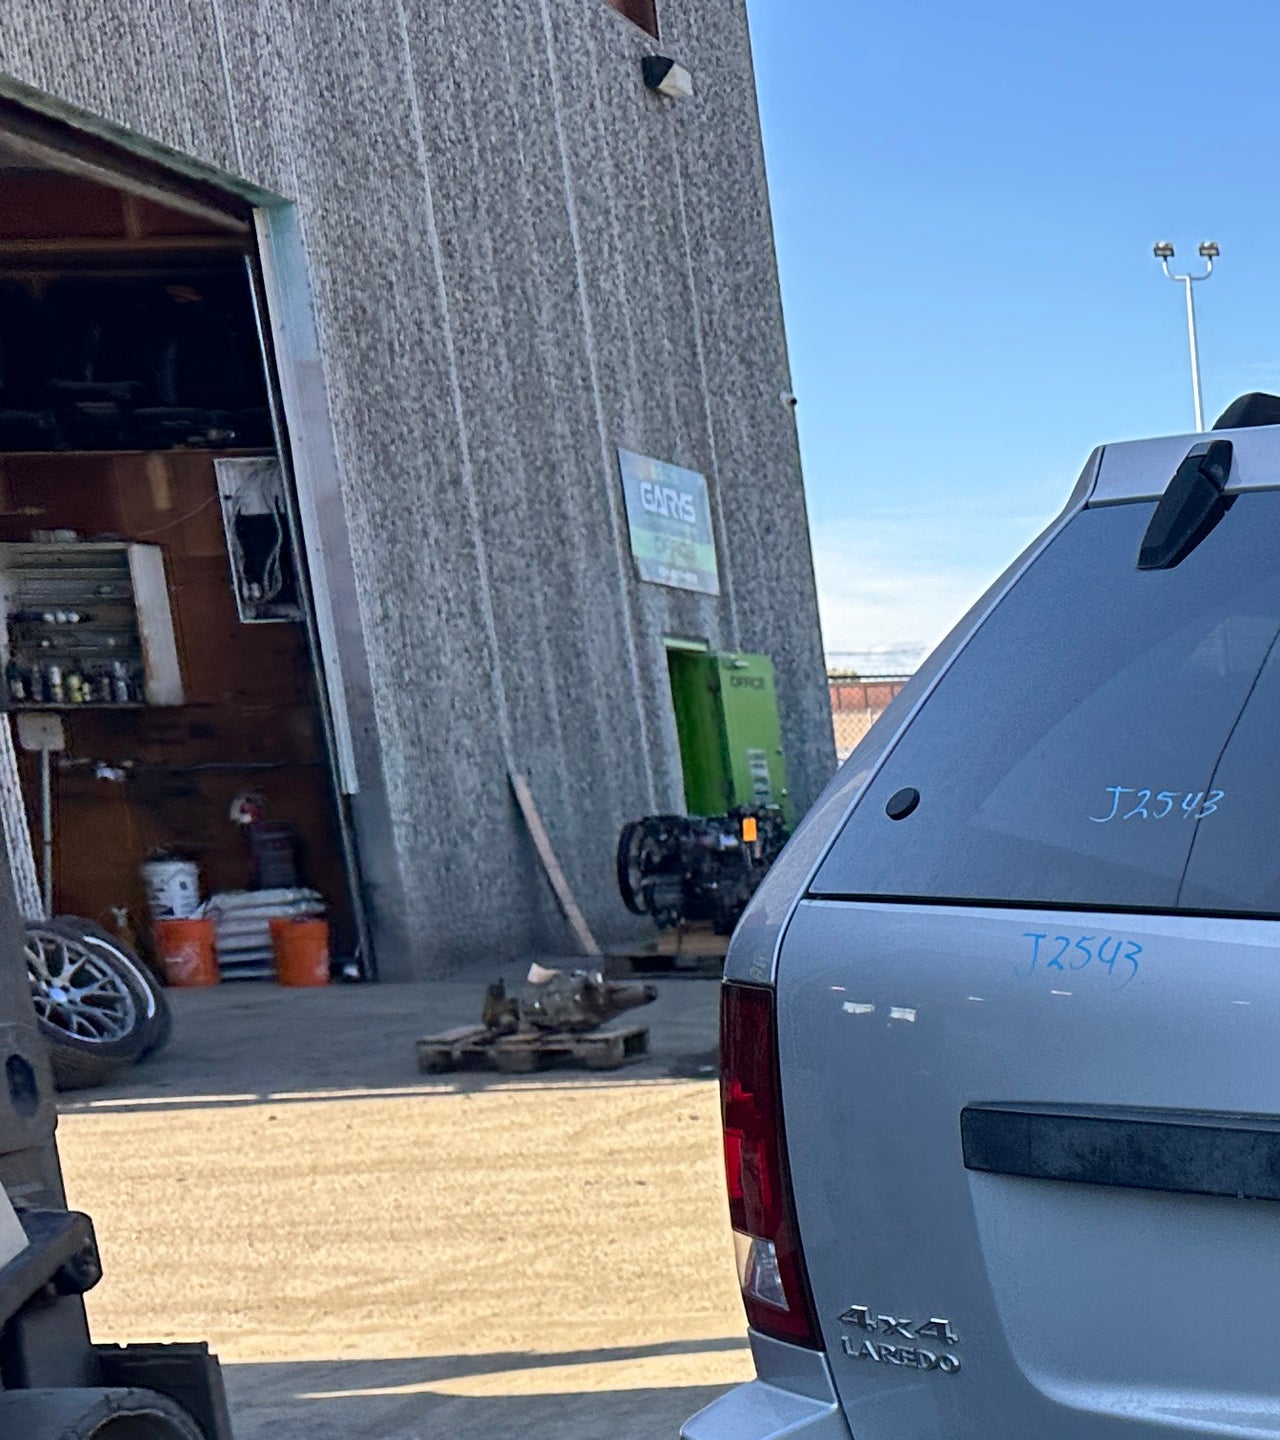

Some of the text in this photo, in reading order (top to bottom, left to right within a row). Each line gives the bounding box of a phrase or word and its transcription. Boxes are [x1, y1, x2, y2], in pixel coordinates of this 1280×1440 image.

[1089, 785, 1225, 823] J2543
[1014, 932, 1144, 989] J2543
[840, 1334, 962, 1374] LAREDO
